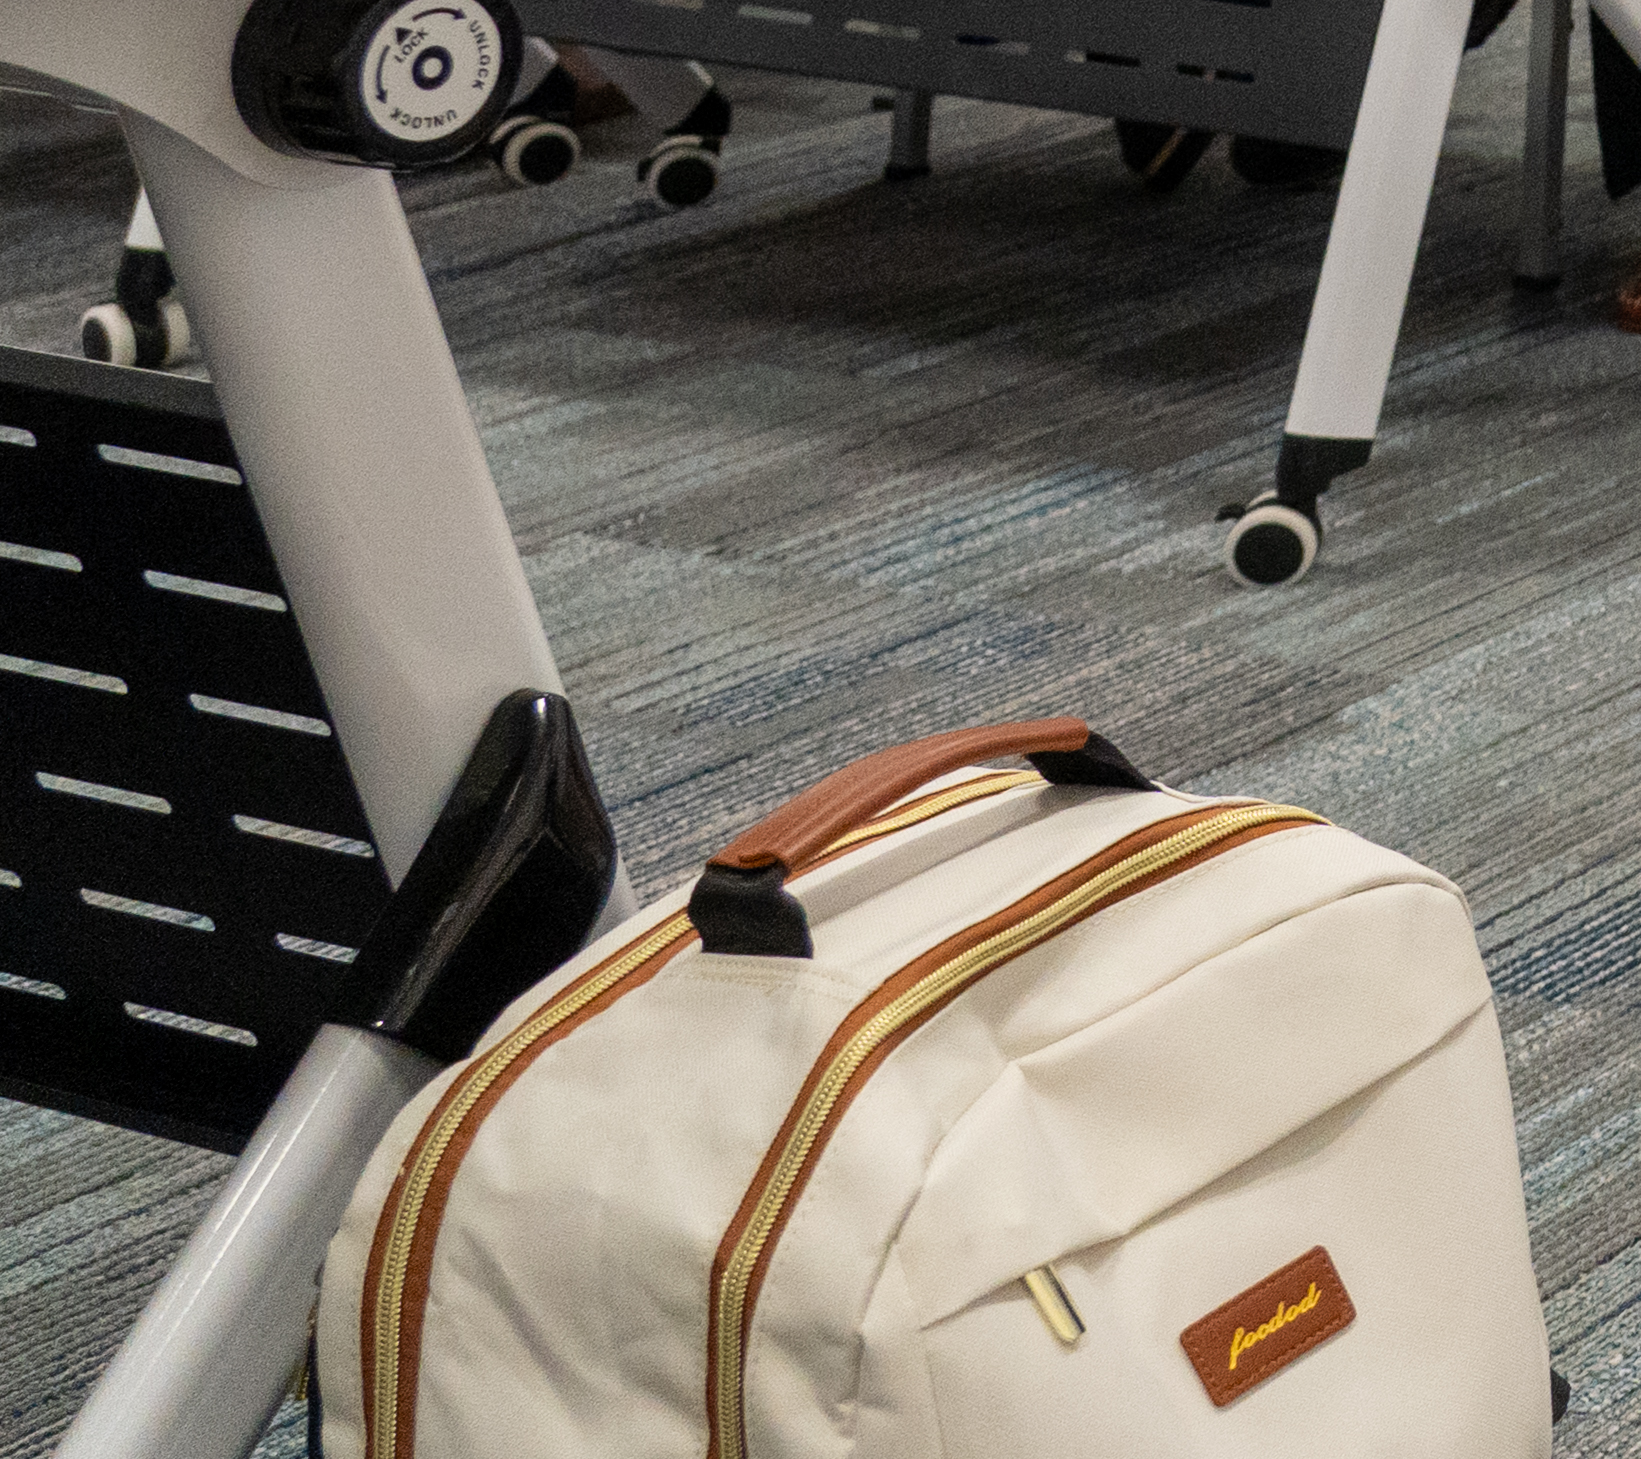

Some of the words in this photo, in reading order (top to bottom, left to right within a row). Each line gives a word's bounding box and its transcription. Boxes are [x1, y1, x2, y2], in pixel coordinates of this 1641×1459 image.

[394, 27, 429, 64] LOCK
[468, 19, 491, 91] UNLOCK
[390, 107, 458, 129] UNLOCK
